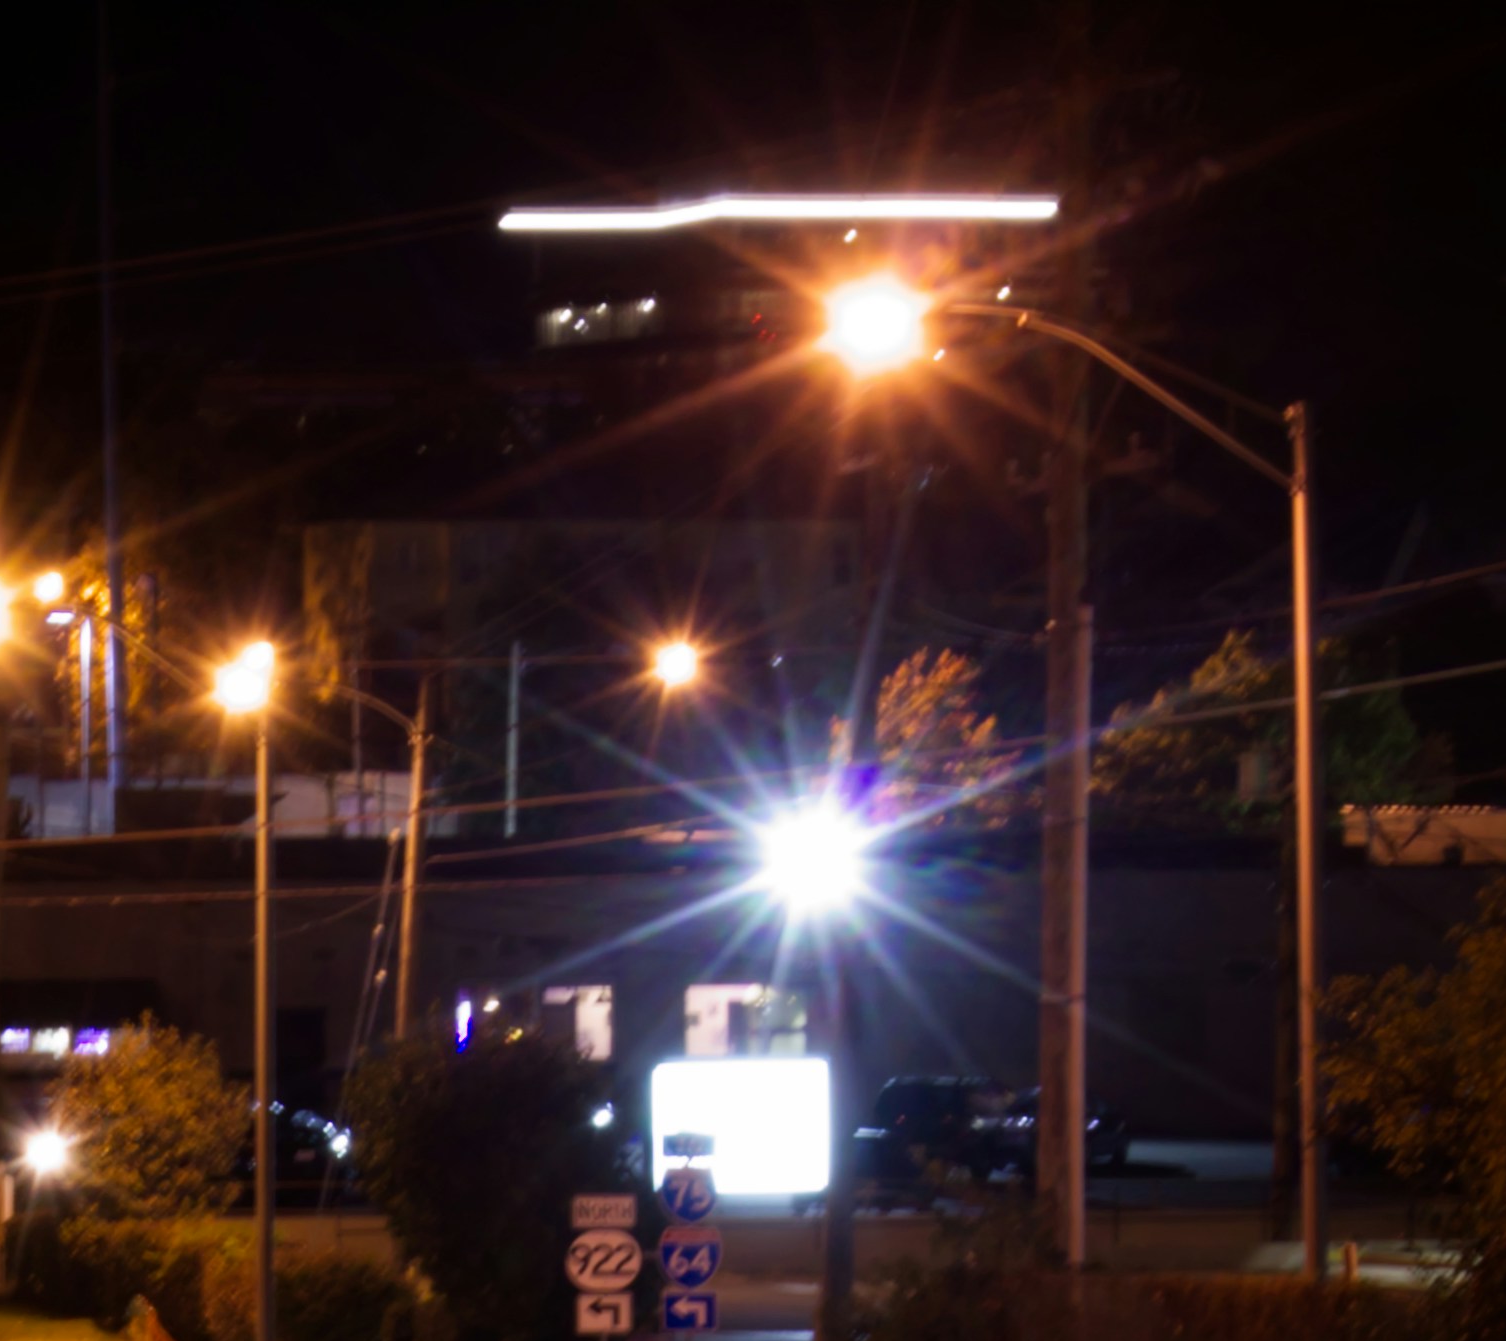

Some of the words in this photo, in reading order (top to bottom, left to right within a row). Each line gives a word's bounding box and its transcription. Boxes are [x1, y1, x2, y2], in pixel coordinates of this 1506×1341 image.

[578, 1200, 633, 1219] NORTH
[668, 1178, 714, 1214] 75
[570, 1242, 637, 1277] 922
[667, 1245, 713, 1278] 64
